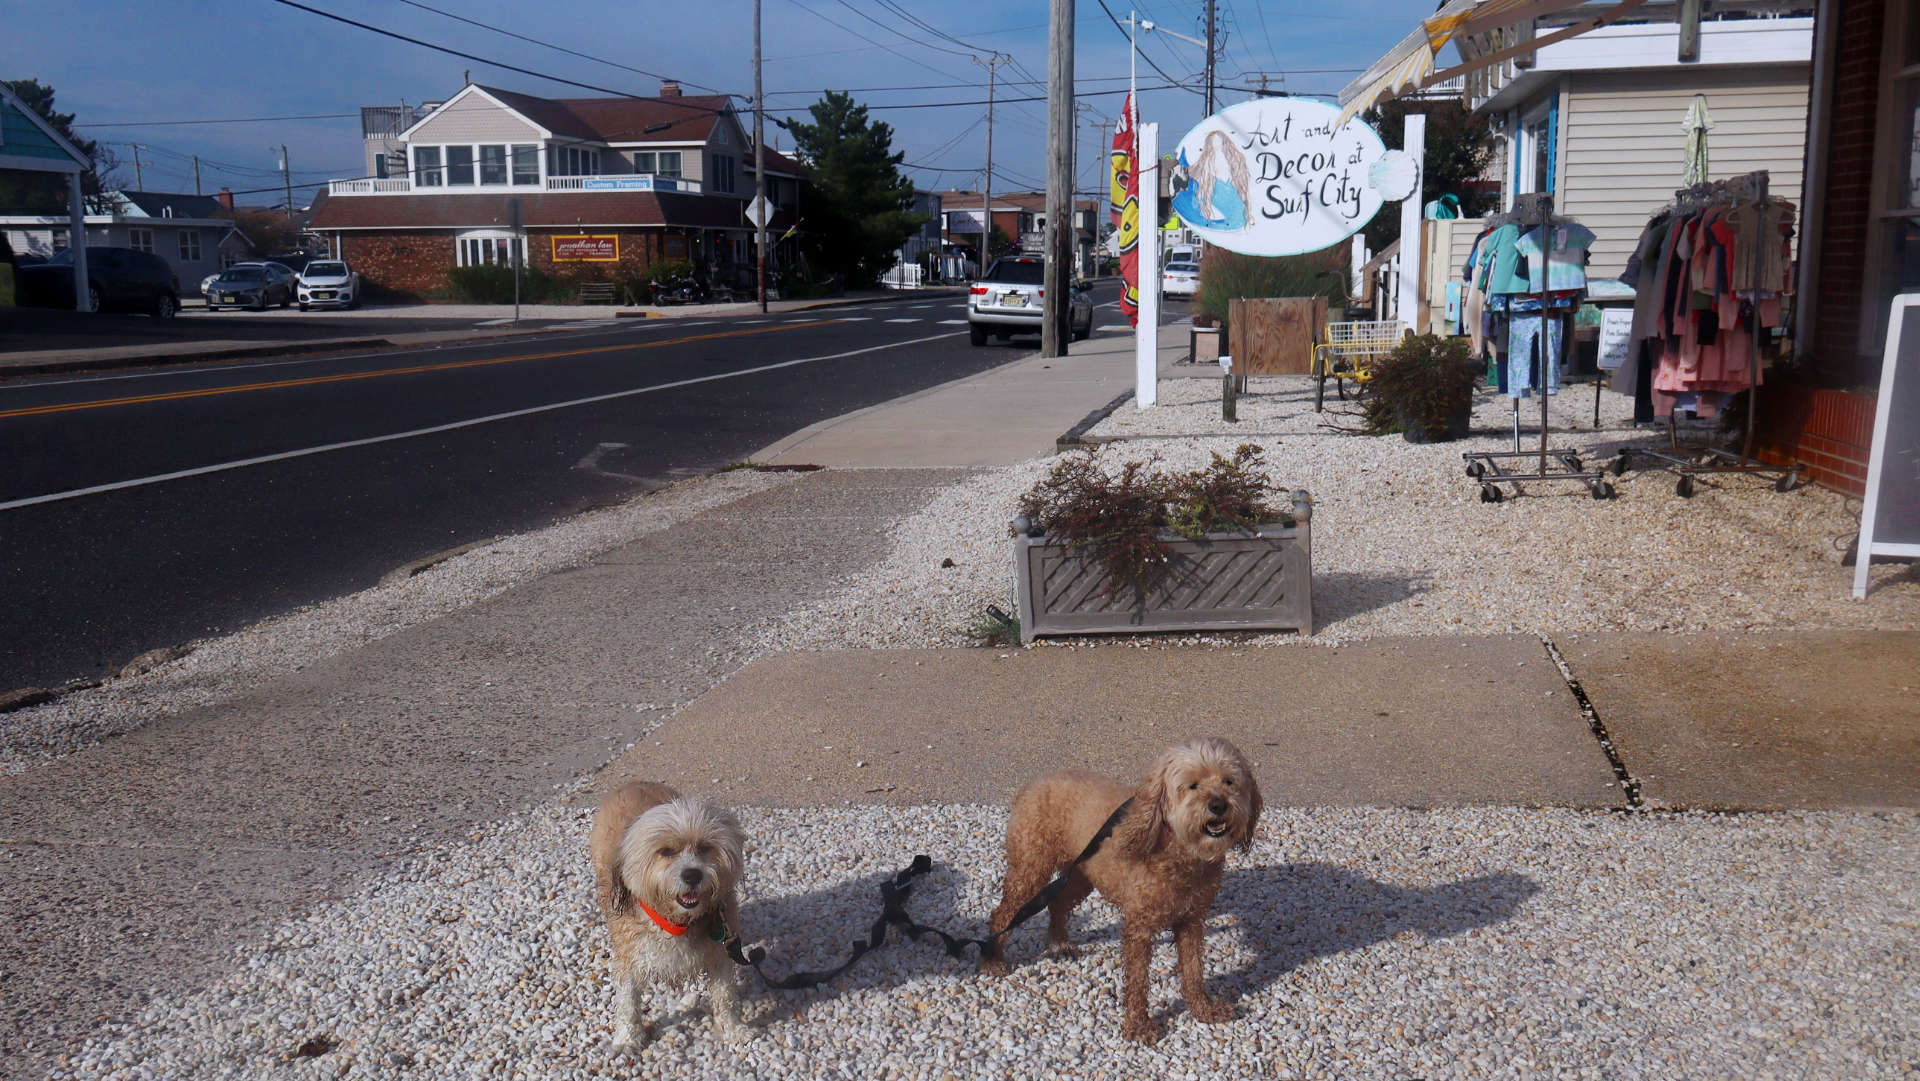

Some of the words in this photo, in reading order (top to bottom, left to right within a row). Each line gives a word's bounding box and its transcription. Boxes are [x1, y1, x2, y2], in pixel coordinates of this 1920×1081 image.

[1242, 109, 1293, 149] Art
[1304, 120, 1331, 138] and
[1255, 150, 1336, 184] Decor
[1348, 141, 1365, 165] at
[1262, 179, 1313, 225] Surf
[1319, 169, 1362, 219] City
